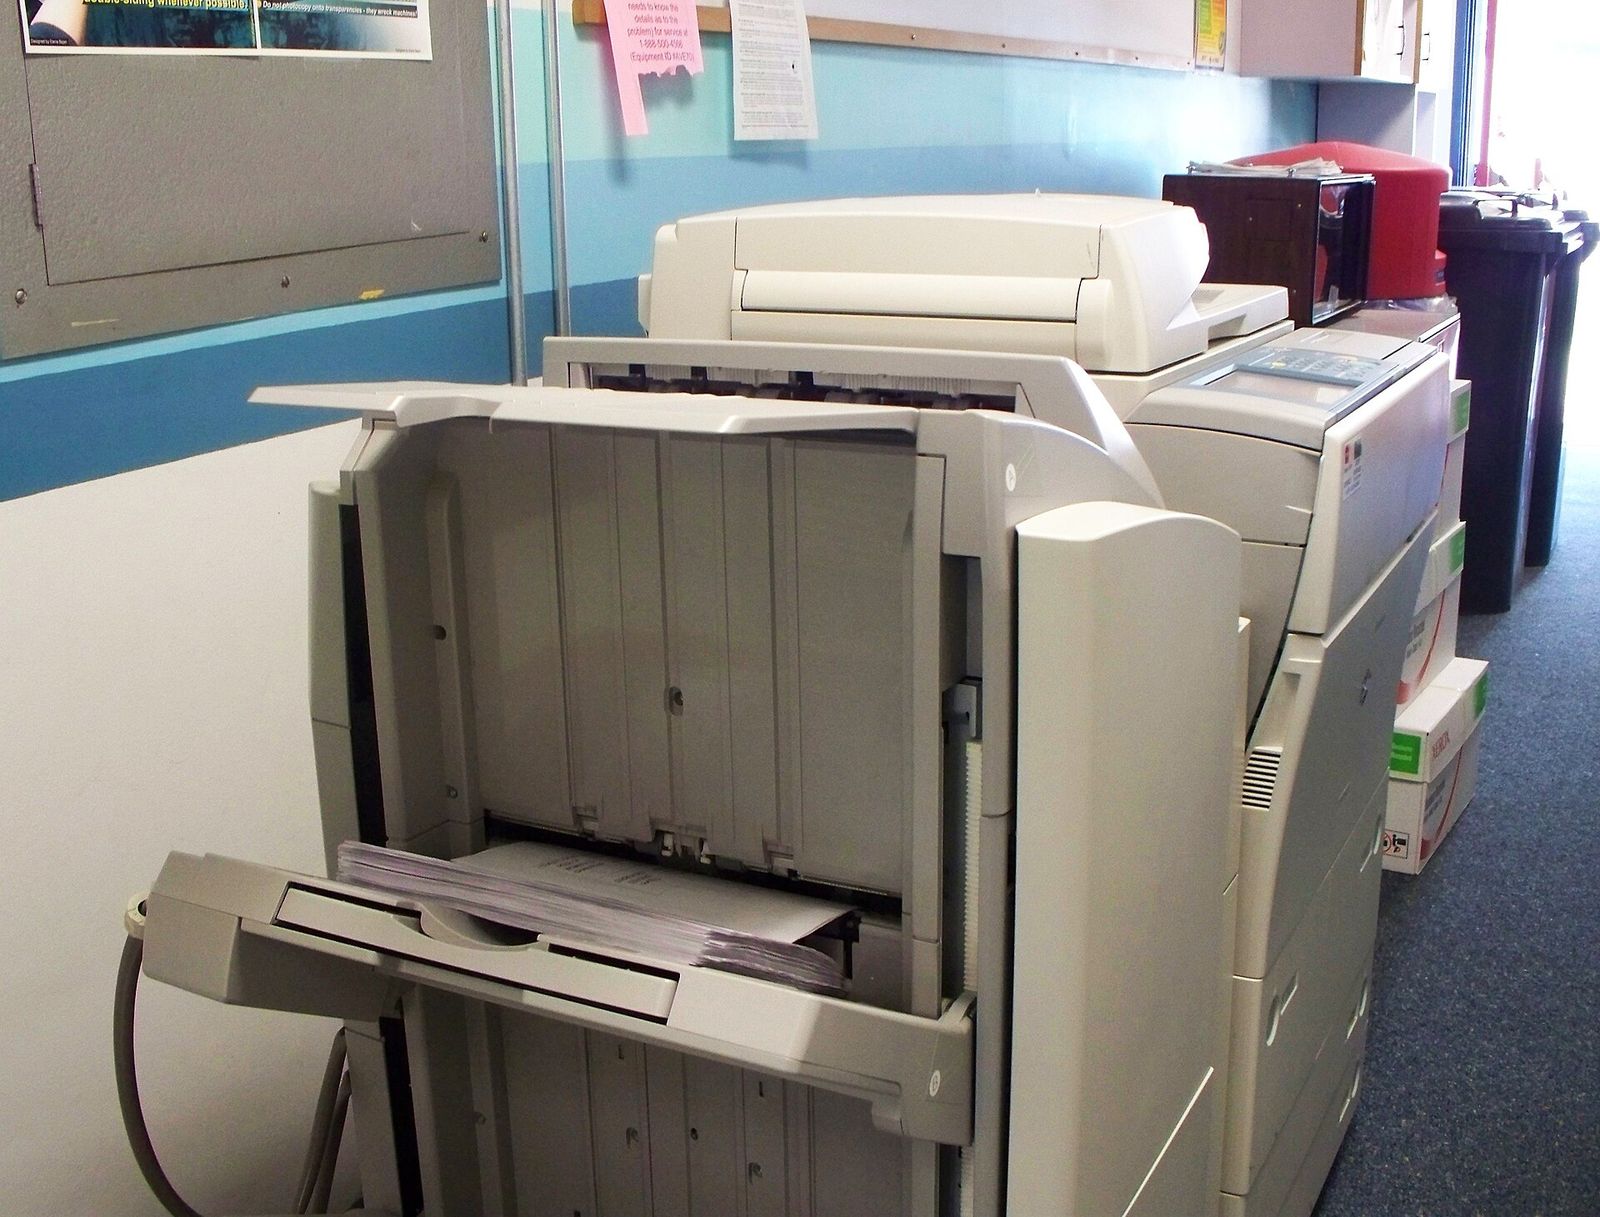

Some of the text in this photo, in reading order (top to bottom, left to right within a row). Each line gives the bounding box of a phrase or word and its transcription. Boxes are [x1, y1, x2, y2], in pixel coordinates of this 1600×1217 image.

[282, 2, 312, 12] photocopy
[366, 7, 377, 16] they
[377, 8, 392, 16] wreck
[628, 3, 679, 12] needs to know the
[634, 15, 653, 23] details
[663, 16, 668, 24] to
[669, 16, 679, 24] the
[627, 27, 653, 37] problem)
[654, 27, 662, 36] for
[663, 29, 683, 37] service
[630, 51, 664, 62] (Equipment
